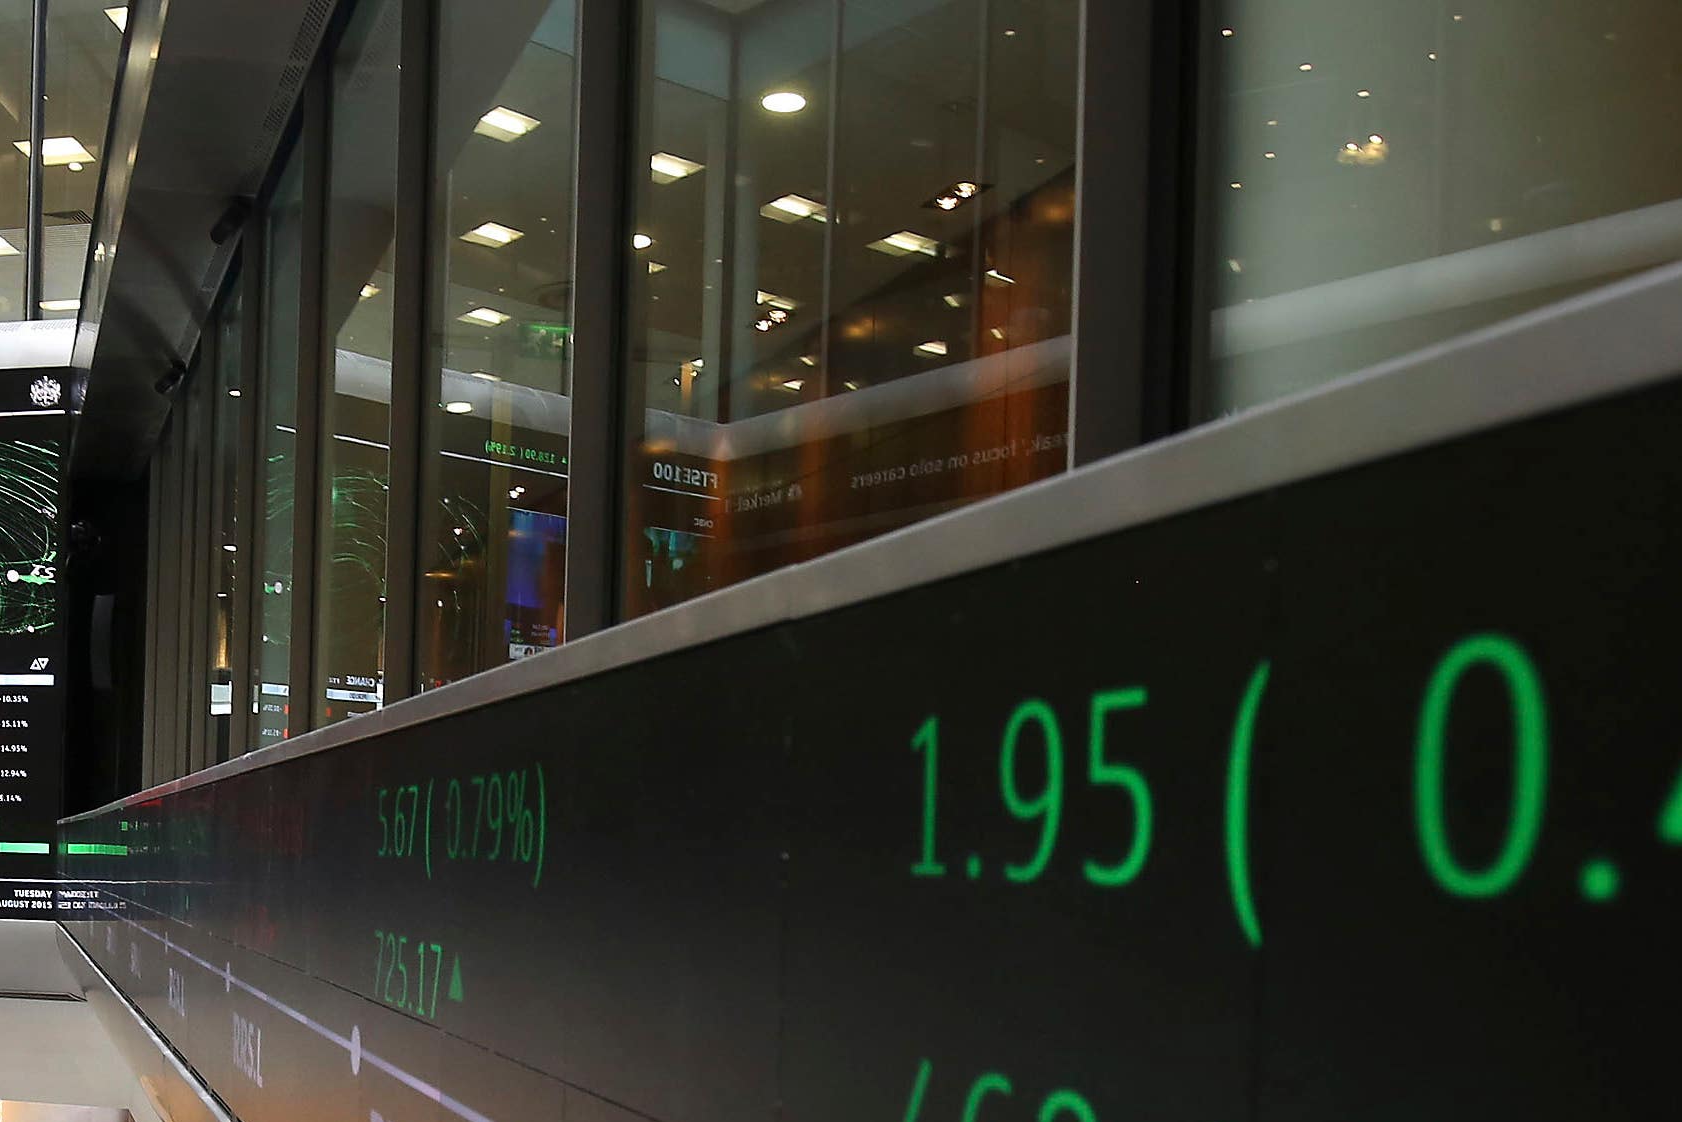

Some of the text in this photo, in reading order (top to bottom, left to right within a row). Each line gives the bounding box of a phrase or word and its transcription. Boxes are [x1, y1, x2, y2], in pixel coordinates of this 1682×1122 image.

[912, 687, 1154, 887] 1.95
[1412, 632, 1682, 900] 0.
[377, 784, 419, 857] 5.67
[14, 889, 53, 899] TUESDAY
[31, 900, 53, 909] 2015
